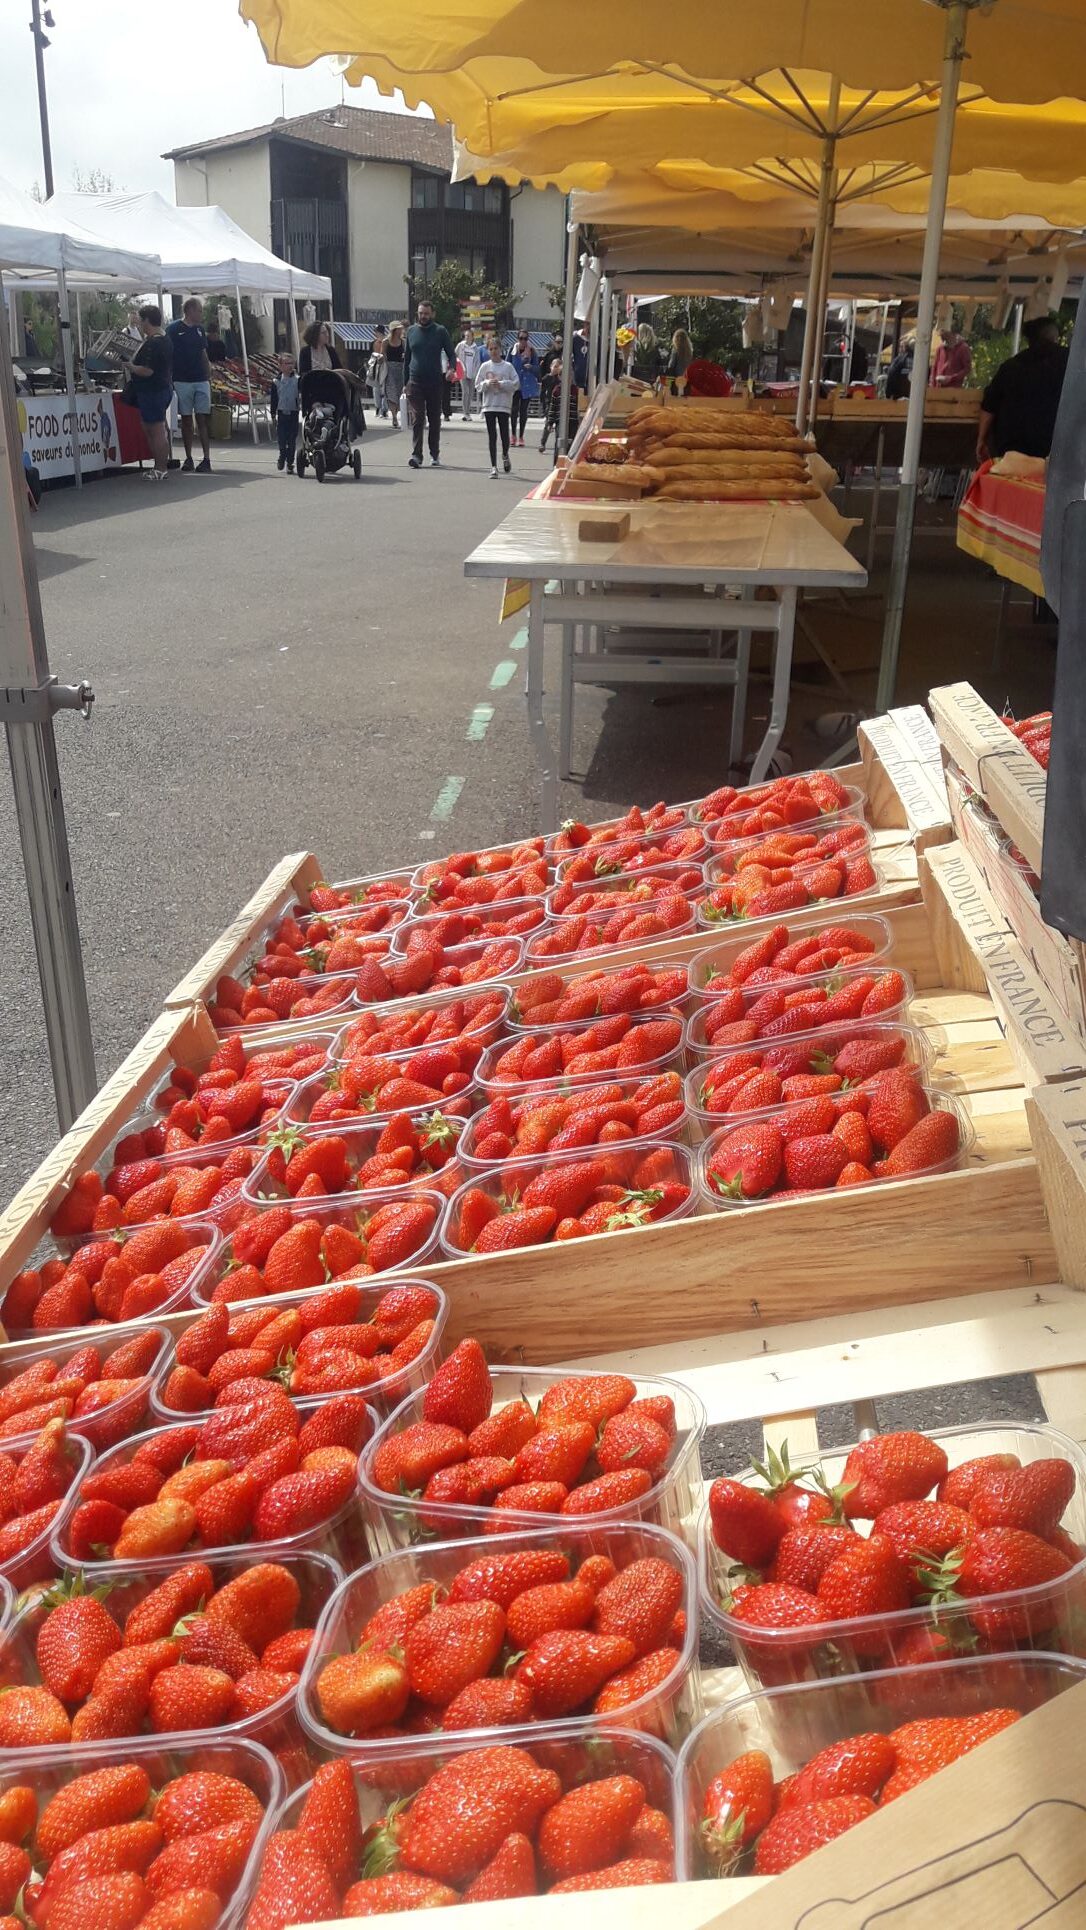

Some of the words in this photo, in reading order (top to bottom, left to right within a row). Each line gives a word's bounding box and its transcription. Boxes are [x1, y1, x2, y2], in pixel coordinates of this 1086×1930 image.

[28, 415, 59, 439] FOOD
[31, 446, 63, 462] saveurs
[952, 693, 1007, 739] FRANCE
[868, 724, 902, 762] PRODUIT
[896, 775, 935, 817] FRANCE
[943, 857, 996, 928] PRODUIT
[974, 930, 1011, 959] EN
[989, 958, 1066, 1047] FRANCE
[0, 1138, 84, 1240] RODUIT
[98, 1024, 176, 1103] FRANCE
